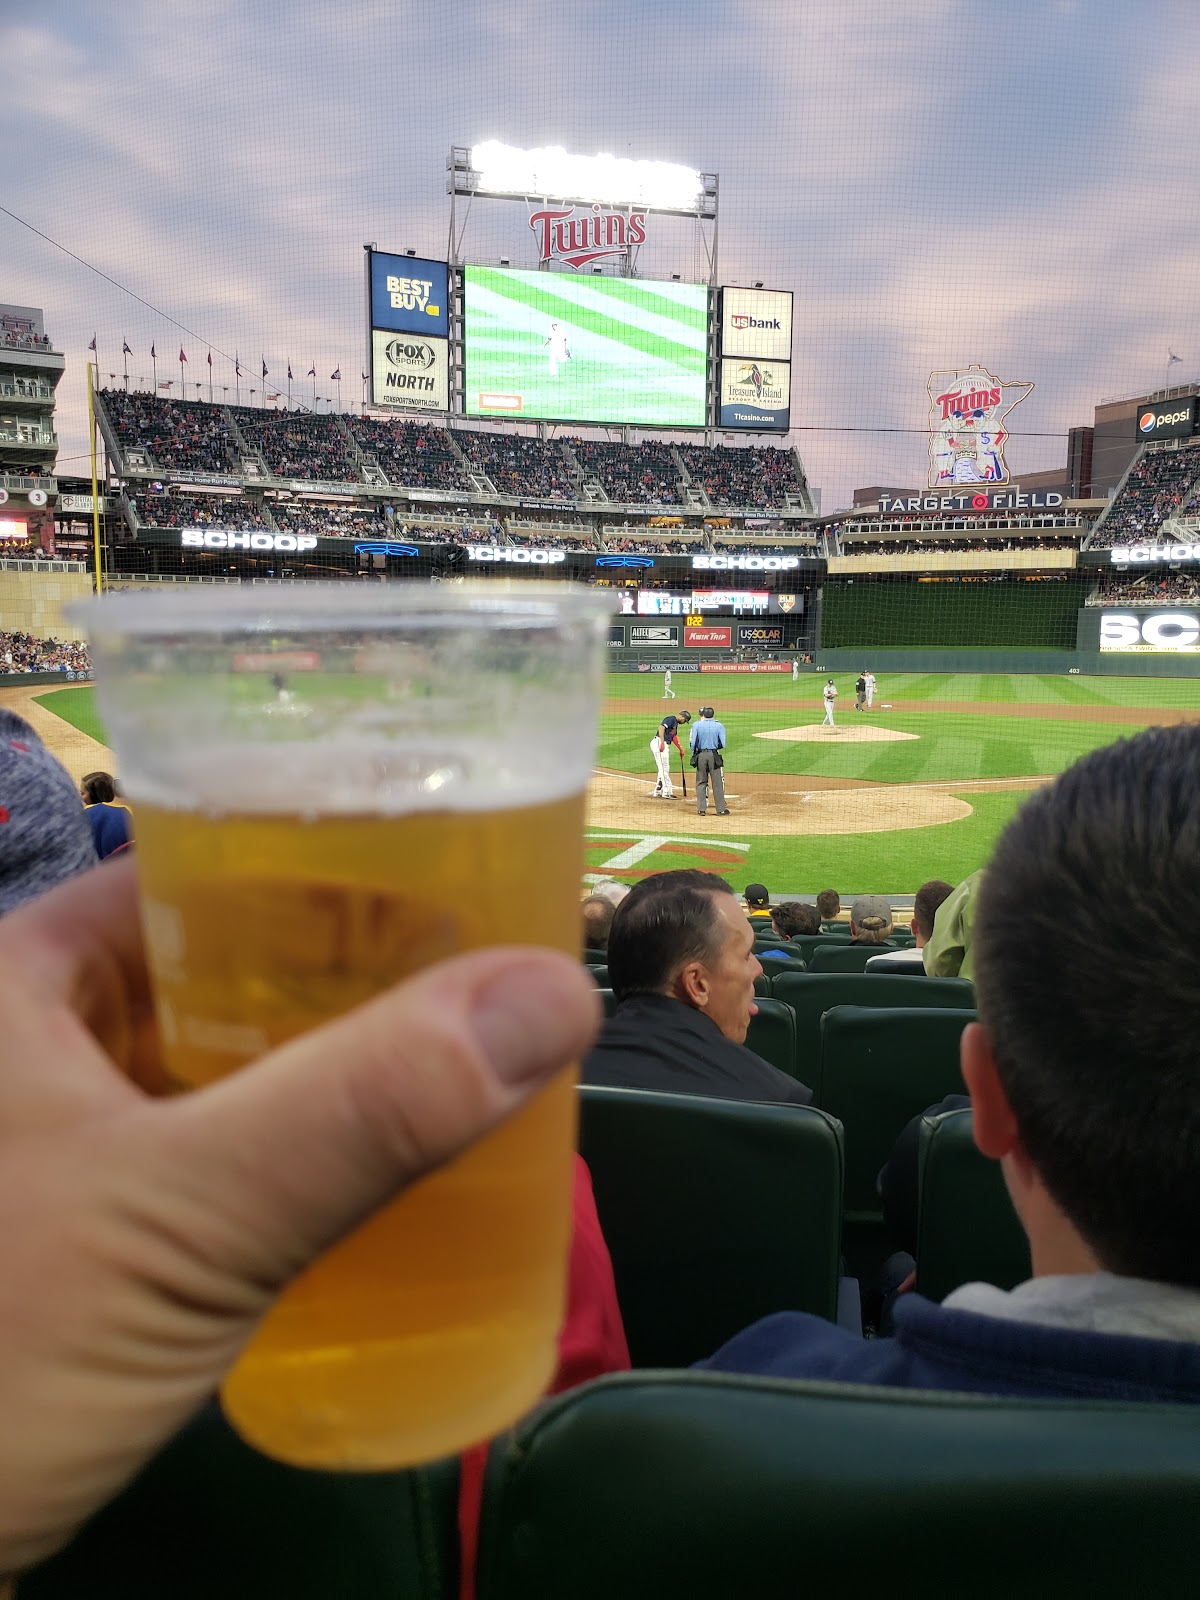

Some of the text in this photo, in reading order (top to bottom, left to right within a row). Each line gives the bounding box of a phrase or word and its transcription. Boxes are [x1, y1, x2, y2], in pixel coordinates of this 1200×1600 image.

[529, 204, 646, 261] Twins
[387, 276, 432, 297] BEST
[391, 293, 429, 312] BUY
[396, 343, 425, 360] FOX
[395, 357, 425, 366] SPORTS
[386, 372, 434, 391] NORTH
[728, 384, 782, 398] Treasure Island
[383, 395, 439, 408] FOXSPORTSNORTH.COM
[936, 387, 1001, 420] Twins
[1157, 408, 1190, 428] pepsi
[878, 493, 1063, 511] TARGET FIELD
[182, 530, 317, 550] SCHOOP
[693, 556, 798, 570] SCHOOP
[687, 616, 702, 626] 0:22
[632, 628, 648, 636] ALTEC
